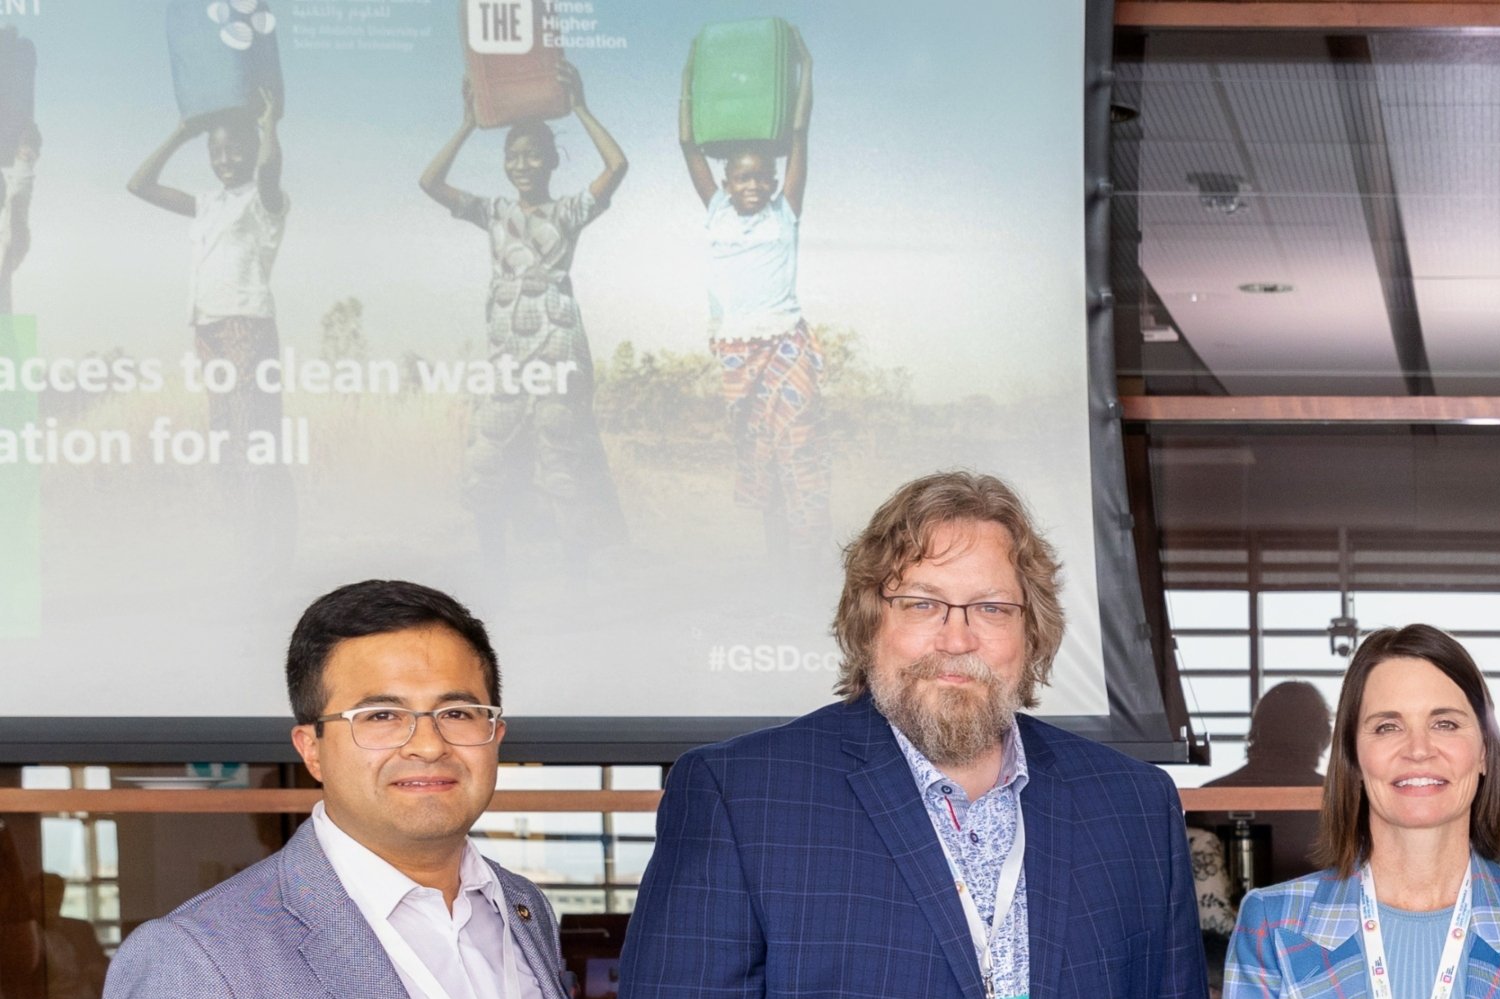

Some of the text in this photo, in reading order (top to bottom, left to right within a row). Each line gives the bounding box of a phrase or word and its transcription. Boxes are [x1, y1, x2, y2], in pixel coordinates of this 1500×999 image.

[543, 0, 594, 13] Times
[479, 3, 522, 42] THE
[542, 16, 598, 33] Higher
[543, 33, 628, 49] Education
[0, 346, 578, 395] access to clean water
[0, 416, 310, 465] ation for all
